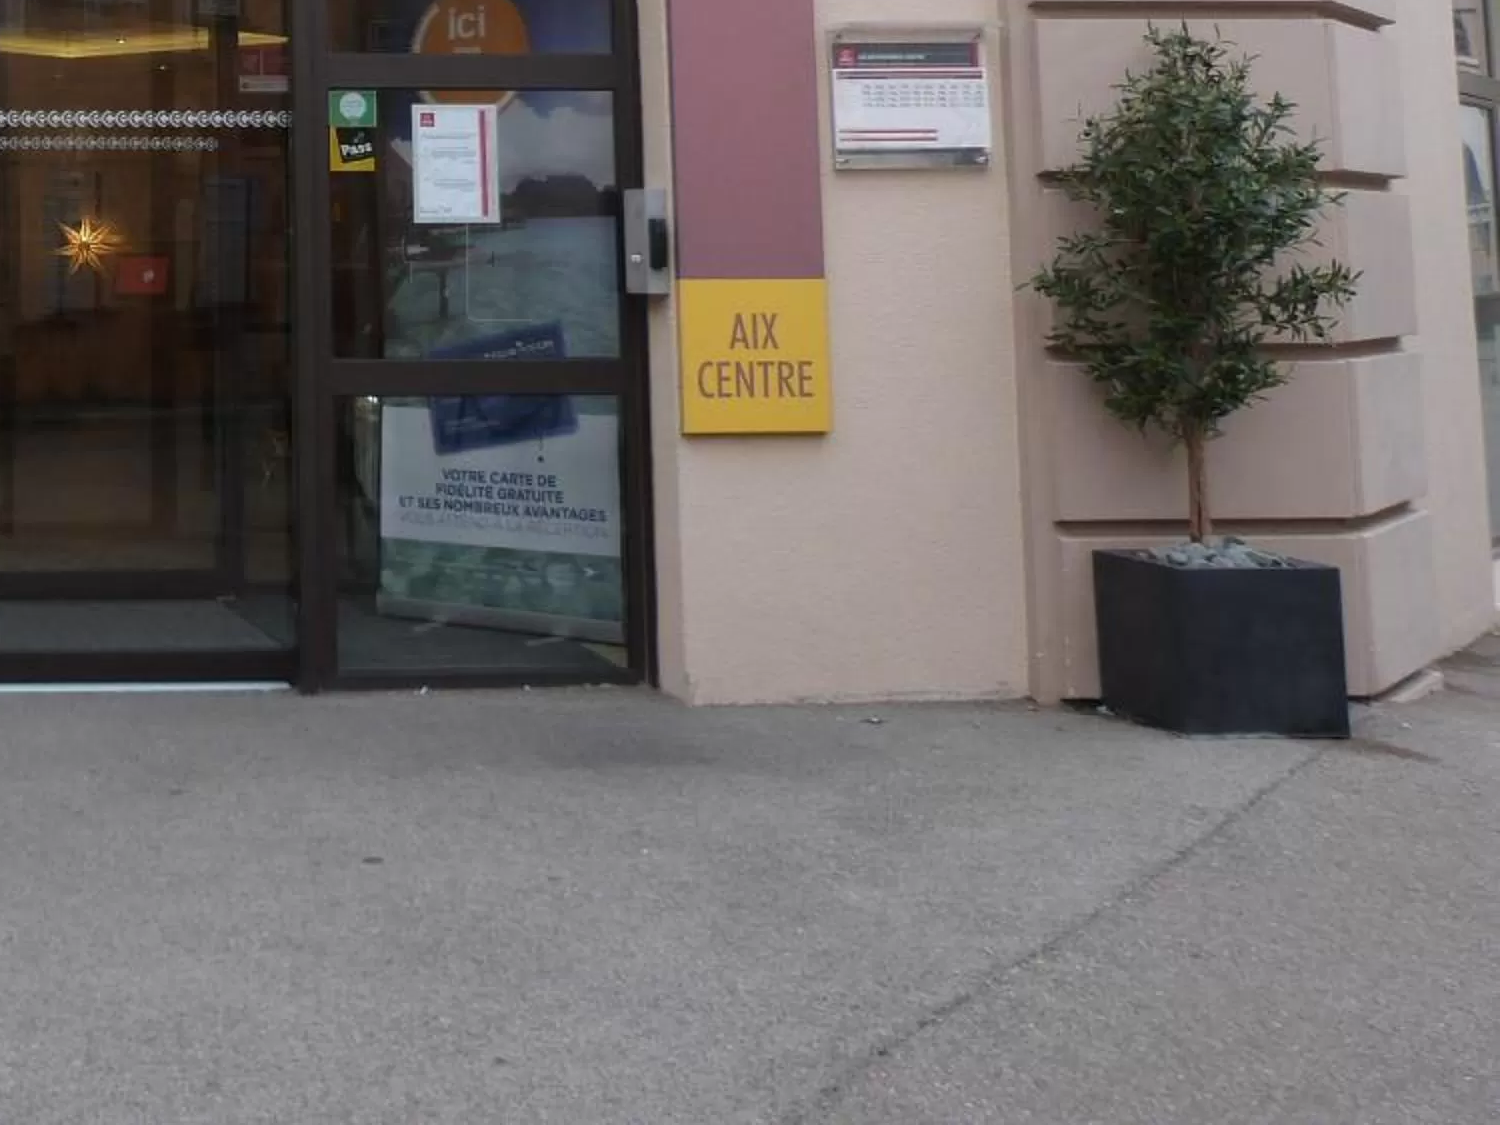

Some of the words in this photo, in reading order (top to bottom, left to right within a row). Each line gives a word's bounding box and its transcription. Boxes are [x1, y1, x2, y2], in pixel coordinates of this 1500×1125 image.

[729, 312, 780, 350] AIX
[697, 360, 816, 400] CENTRE
[441, 467, 485, 484] VOTRE
[490, 471, 533, 486] CARTE
[538, 474, 557, 488] DE
[497, 487, 565, 504] GRATUITE
[443, 499, 520, 517] NOMBREUX
[523, 506, 608, 523] AVANTAGES
